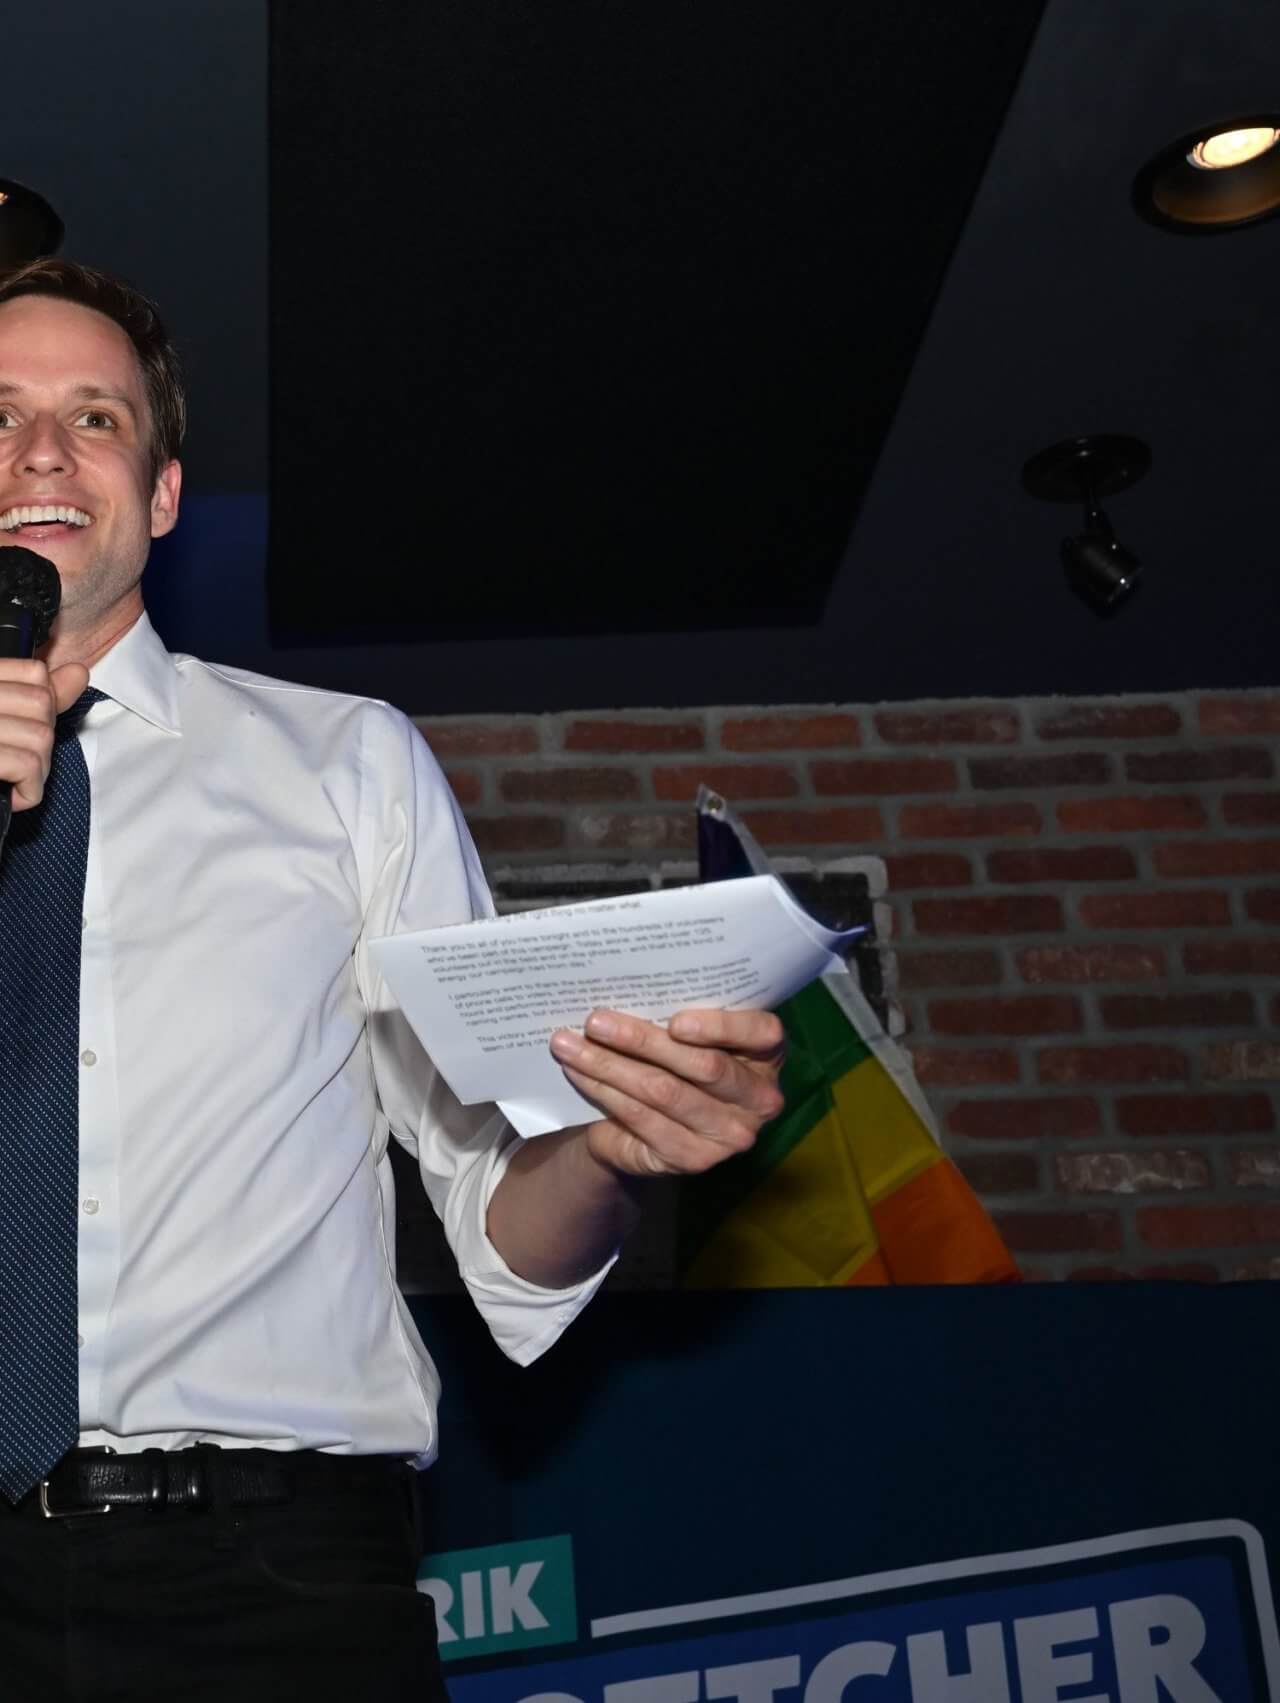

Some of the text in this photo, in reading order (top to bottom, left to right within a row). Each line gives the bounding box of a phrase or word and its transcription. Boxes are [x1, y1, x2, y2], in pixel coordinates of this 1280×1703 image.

[422, 944, 446, 954] Thank
[450, 944, 466, 953] you
[501, 939, 516, 947] you
[540, 931, 570, 941] tonight
[572, 929, 589, 937] and
[416, 1560, 551, 1644] RIK
